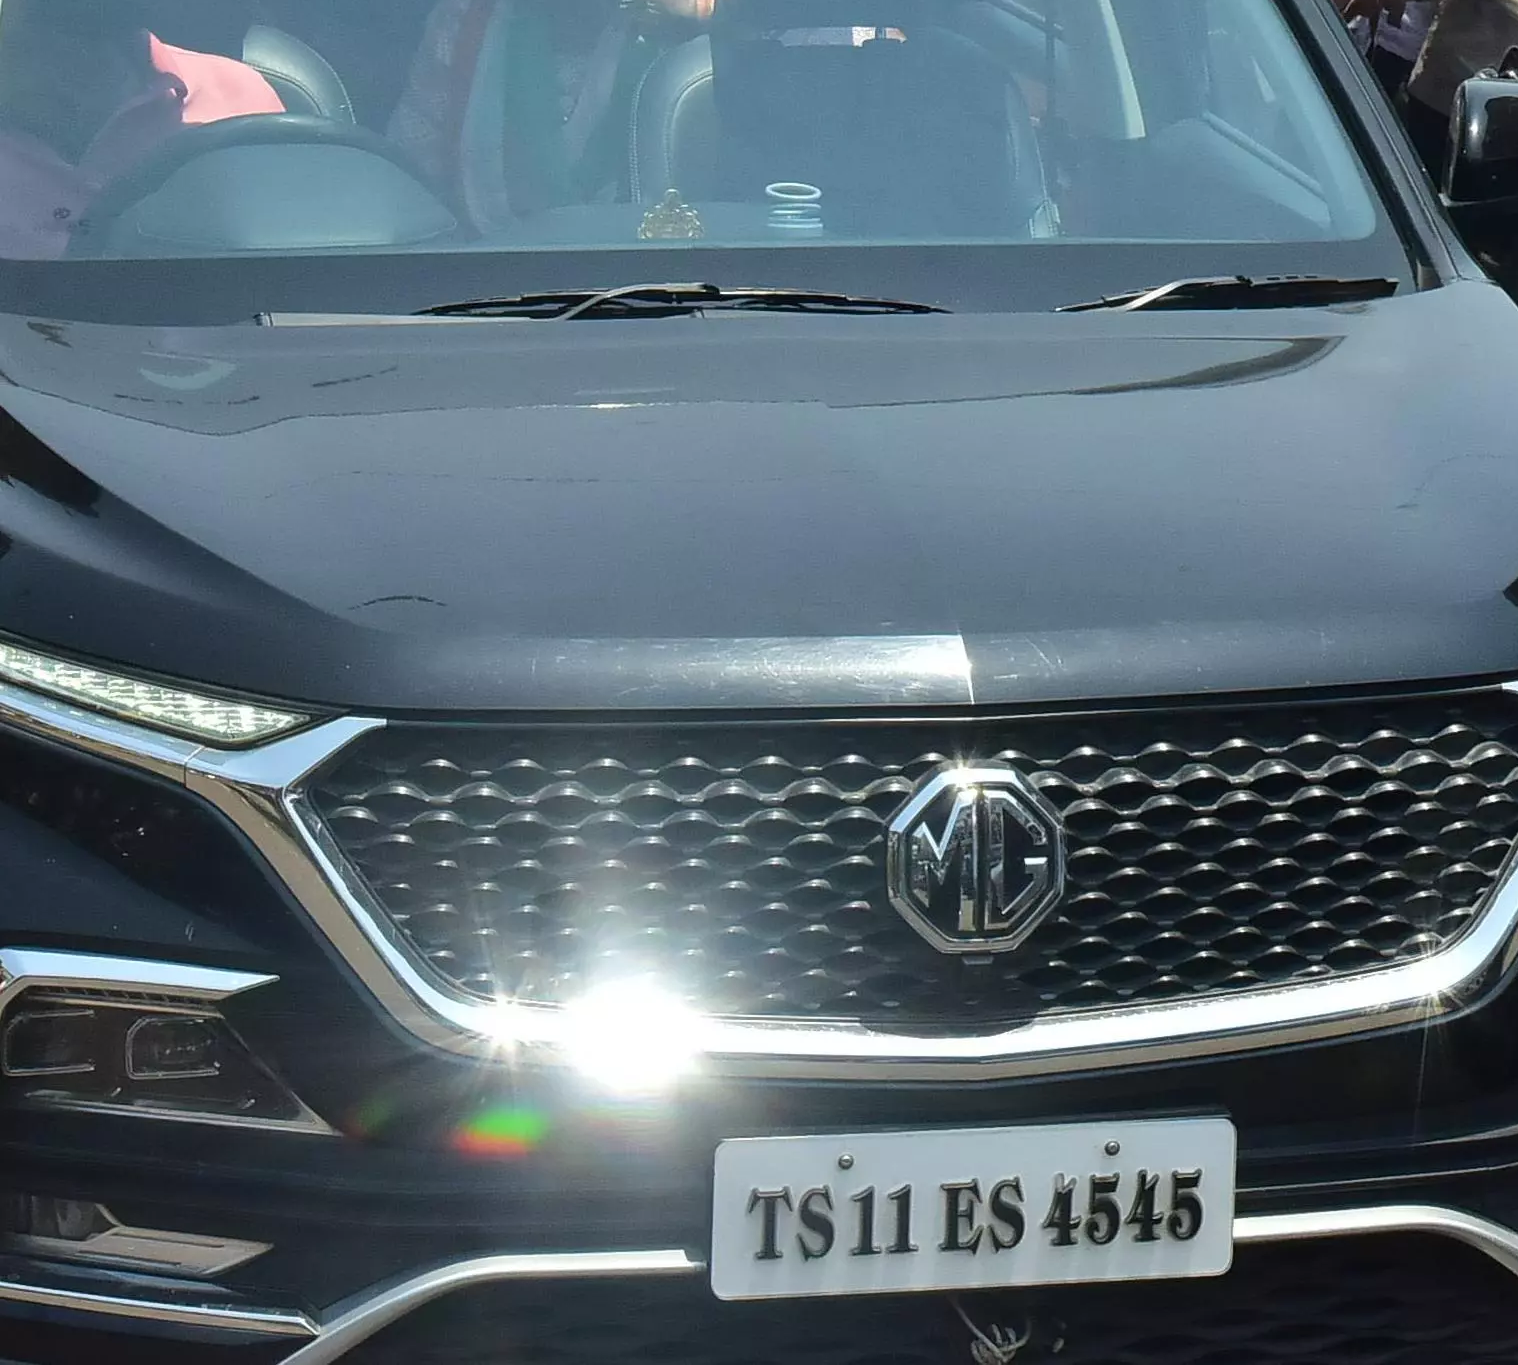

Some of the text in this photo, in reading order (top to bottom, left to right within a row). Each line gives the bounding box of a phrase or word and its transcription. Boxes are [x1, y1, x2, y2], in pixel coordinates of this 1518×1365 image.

[911, 785, 1049, 932] MG
[937, 1176, 1025, 1256] ES
[1041, 1167, 1204, 1248] 4545
